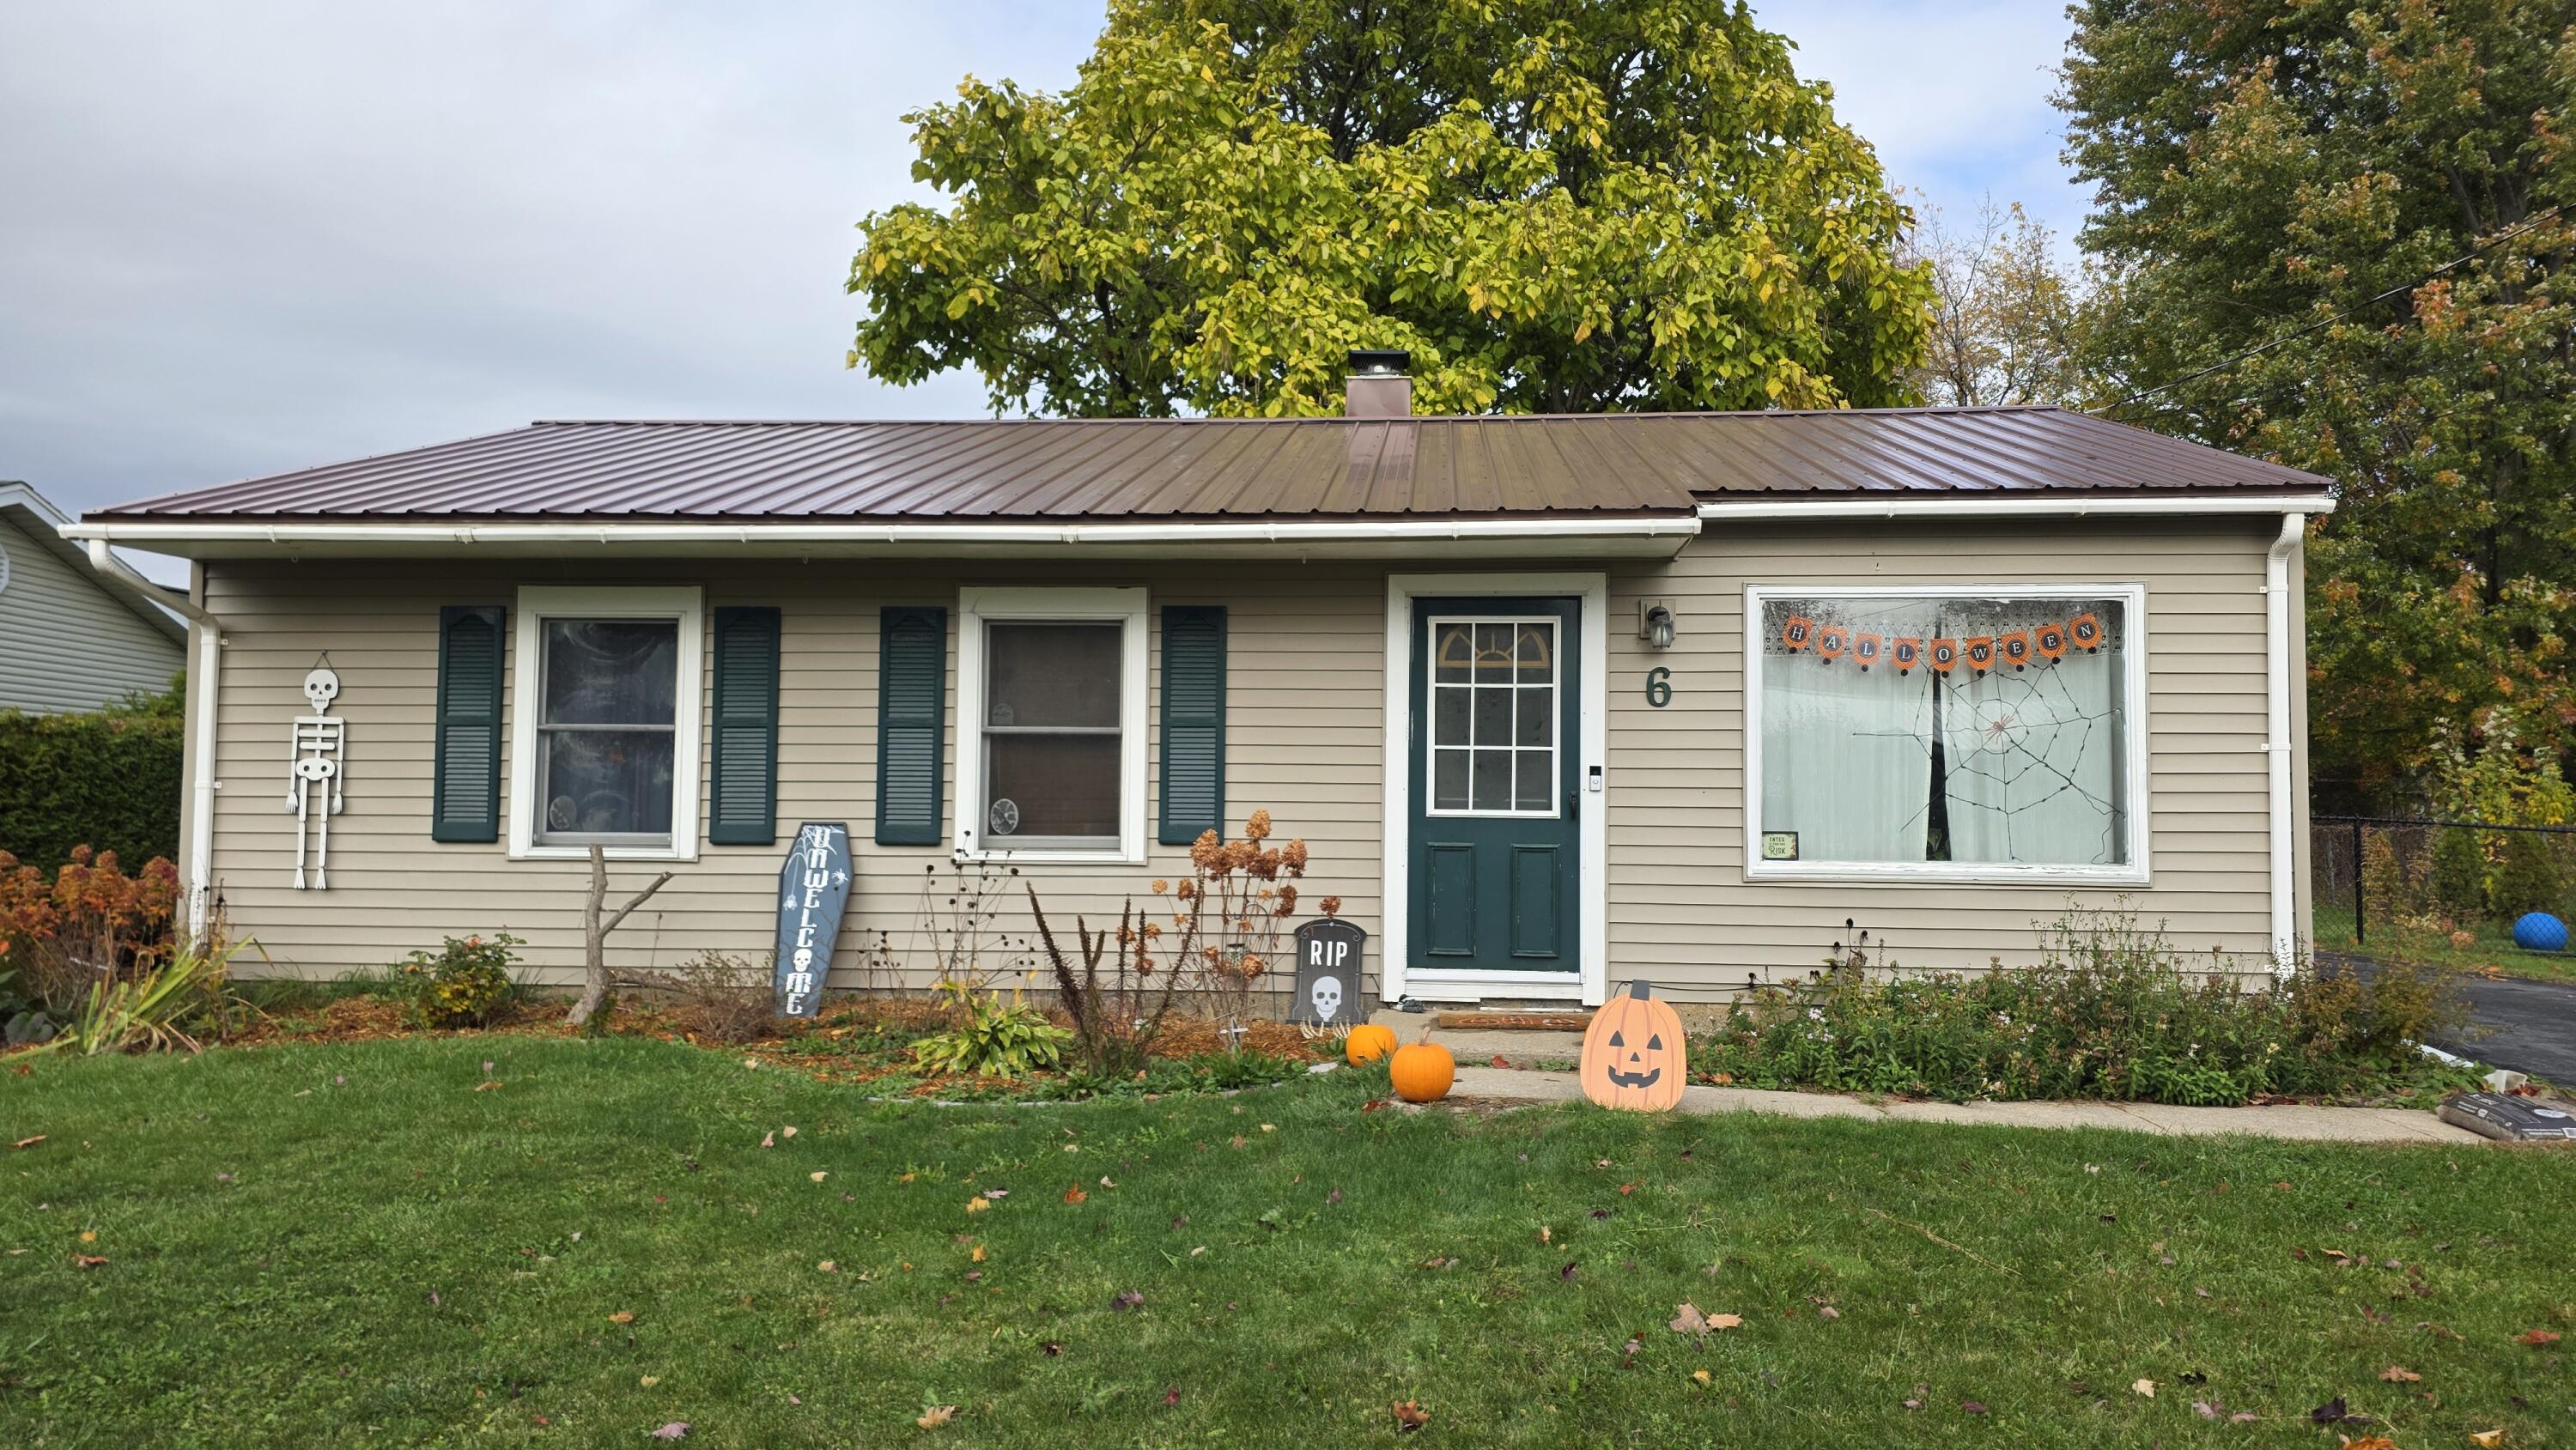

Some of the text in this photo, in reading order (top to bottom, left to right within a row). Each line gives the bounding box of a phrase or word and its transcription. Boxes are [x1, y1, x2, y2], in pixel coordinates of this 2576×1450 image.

[1791, 624, 2092, 659] HALLOWEEN
[1646, 666, 1672, 707] 6
[1769, 846, 1786, 856] RISK
[1310, 939, 1348, 967] RIP
